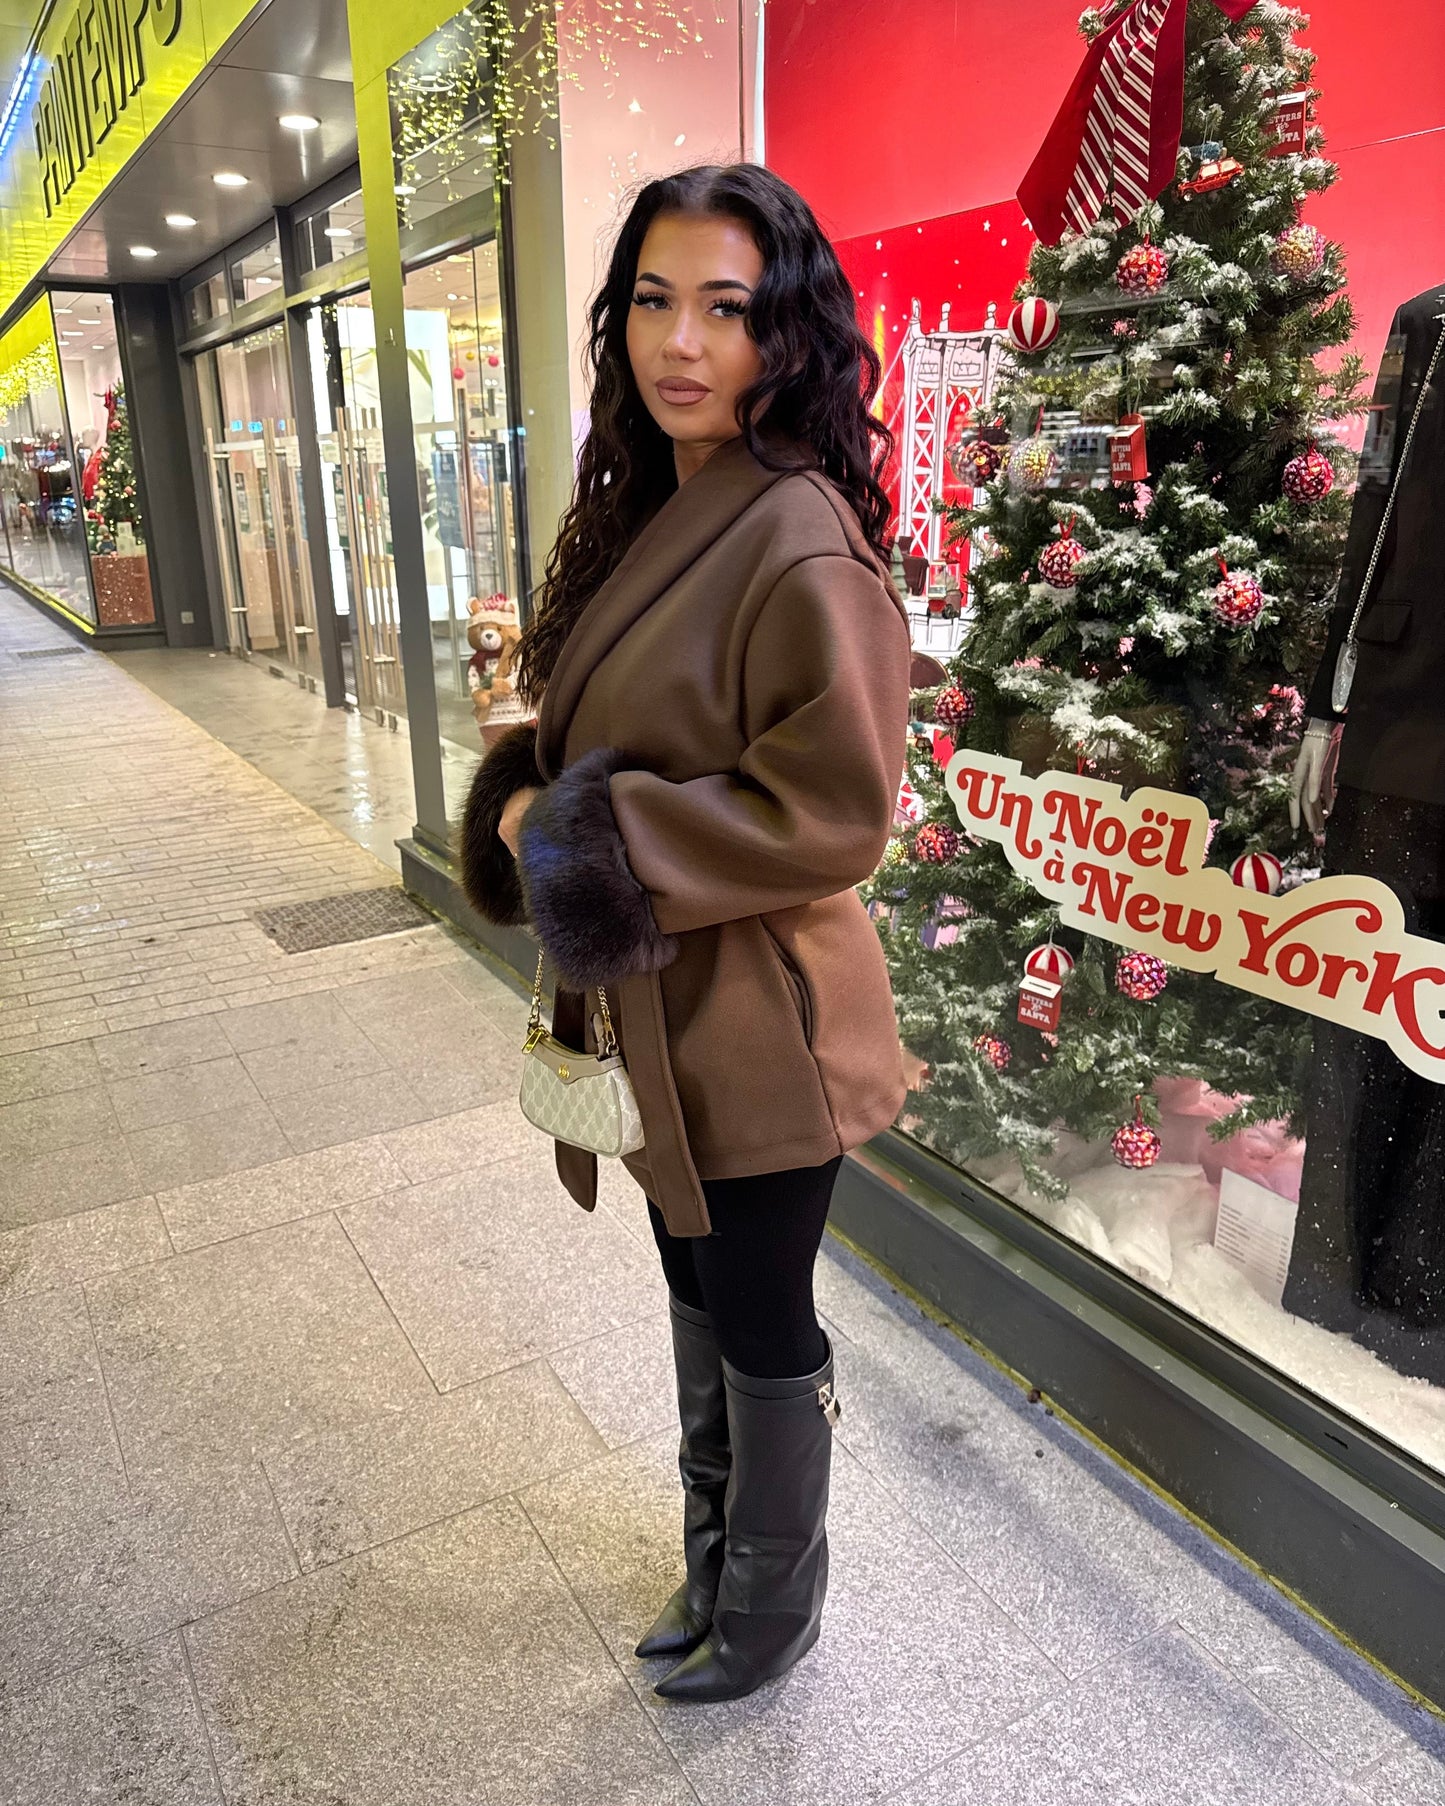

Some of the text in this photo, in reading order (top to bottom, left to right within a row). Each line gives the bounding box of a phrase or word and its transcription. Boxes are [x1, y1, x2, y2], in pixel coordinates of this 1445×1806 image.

[956, 767, 1192, 876] Un Noël
[1043, 849, 1066, 884] à
[1071, 862, 1222, 953] New
[1020, 1007, 1051, 1025] SANTA
